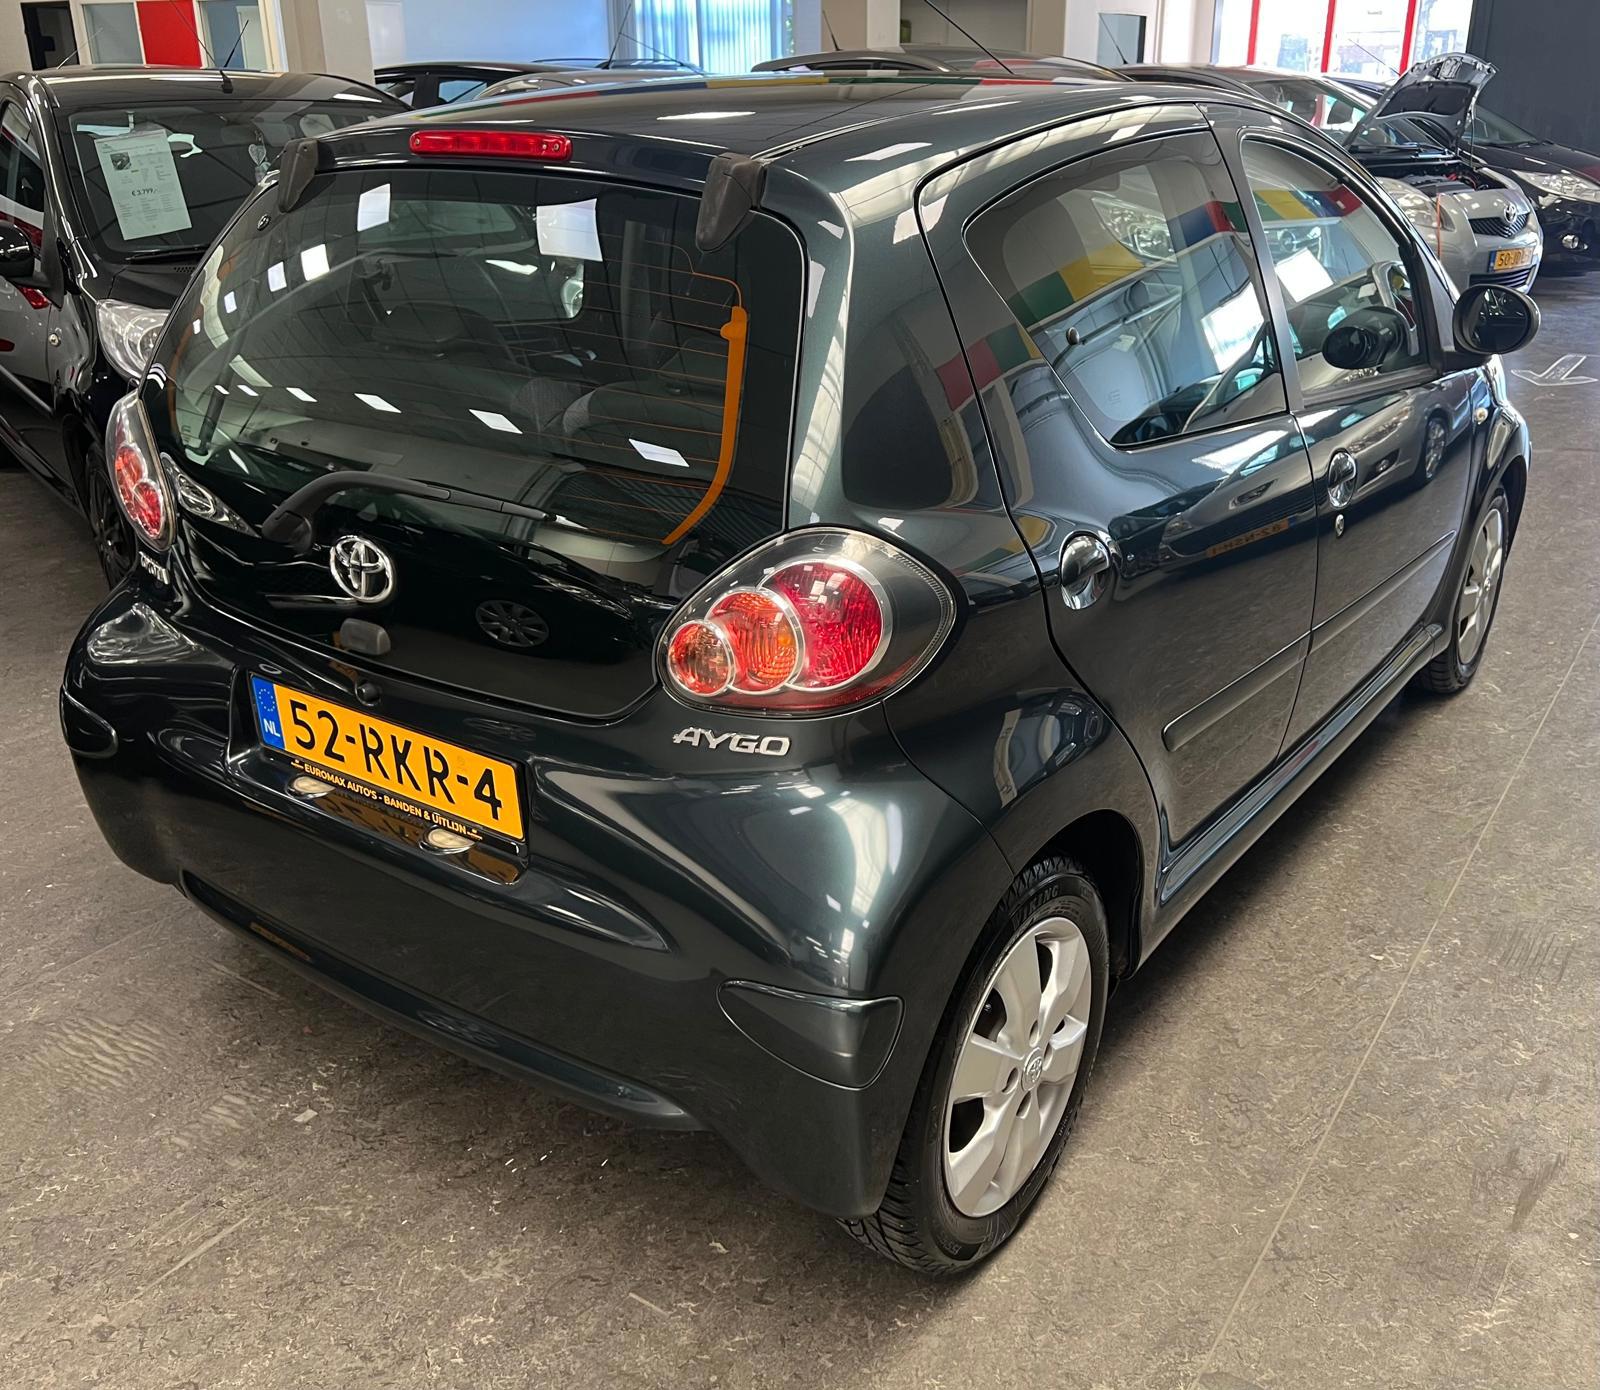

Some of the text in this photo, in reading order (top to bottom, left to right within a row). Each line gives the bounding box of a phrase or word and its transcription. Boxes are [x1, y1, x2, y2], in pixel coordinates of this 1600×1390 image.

[263, 718, 281, 738] NL
[672, 726, 790, 756] AYGO
[289, 699, 502, 821] 52-RKR-4
[304, 763, 346, 788] EUROMAX
[346, 781, 378, 800] AUTO'S
[383, 795, 422, 818] BANDEN
[423, 810, 431, 821] &
